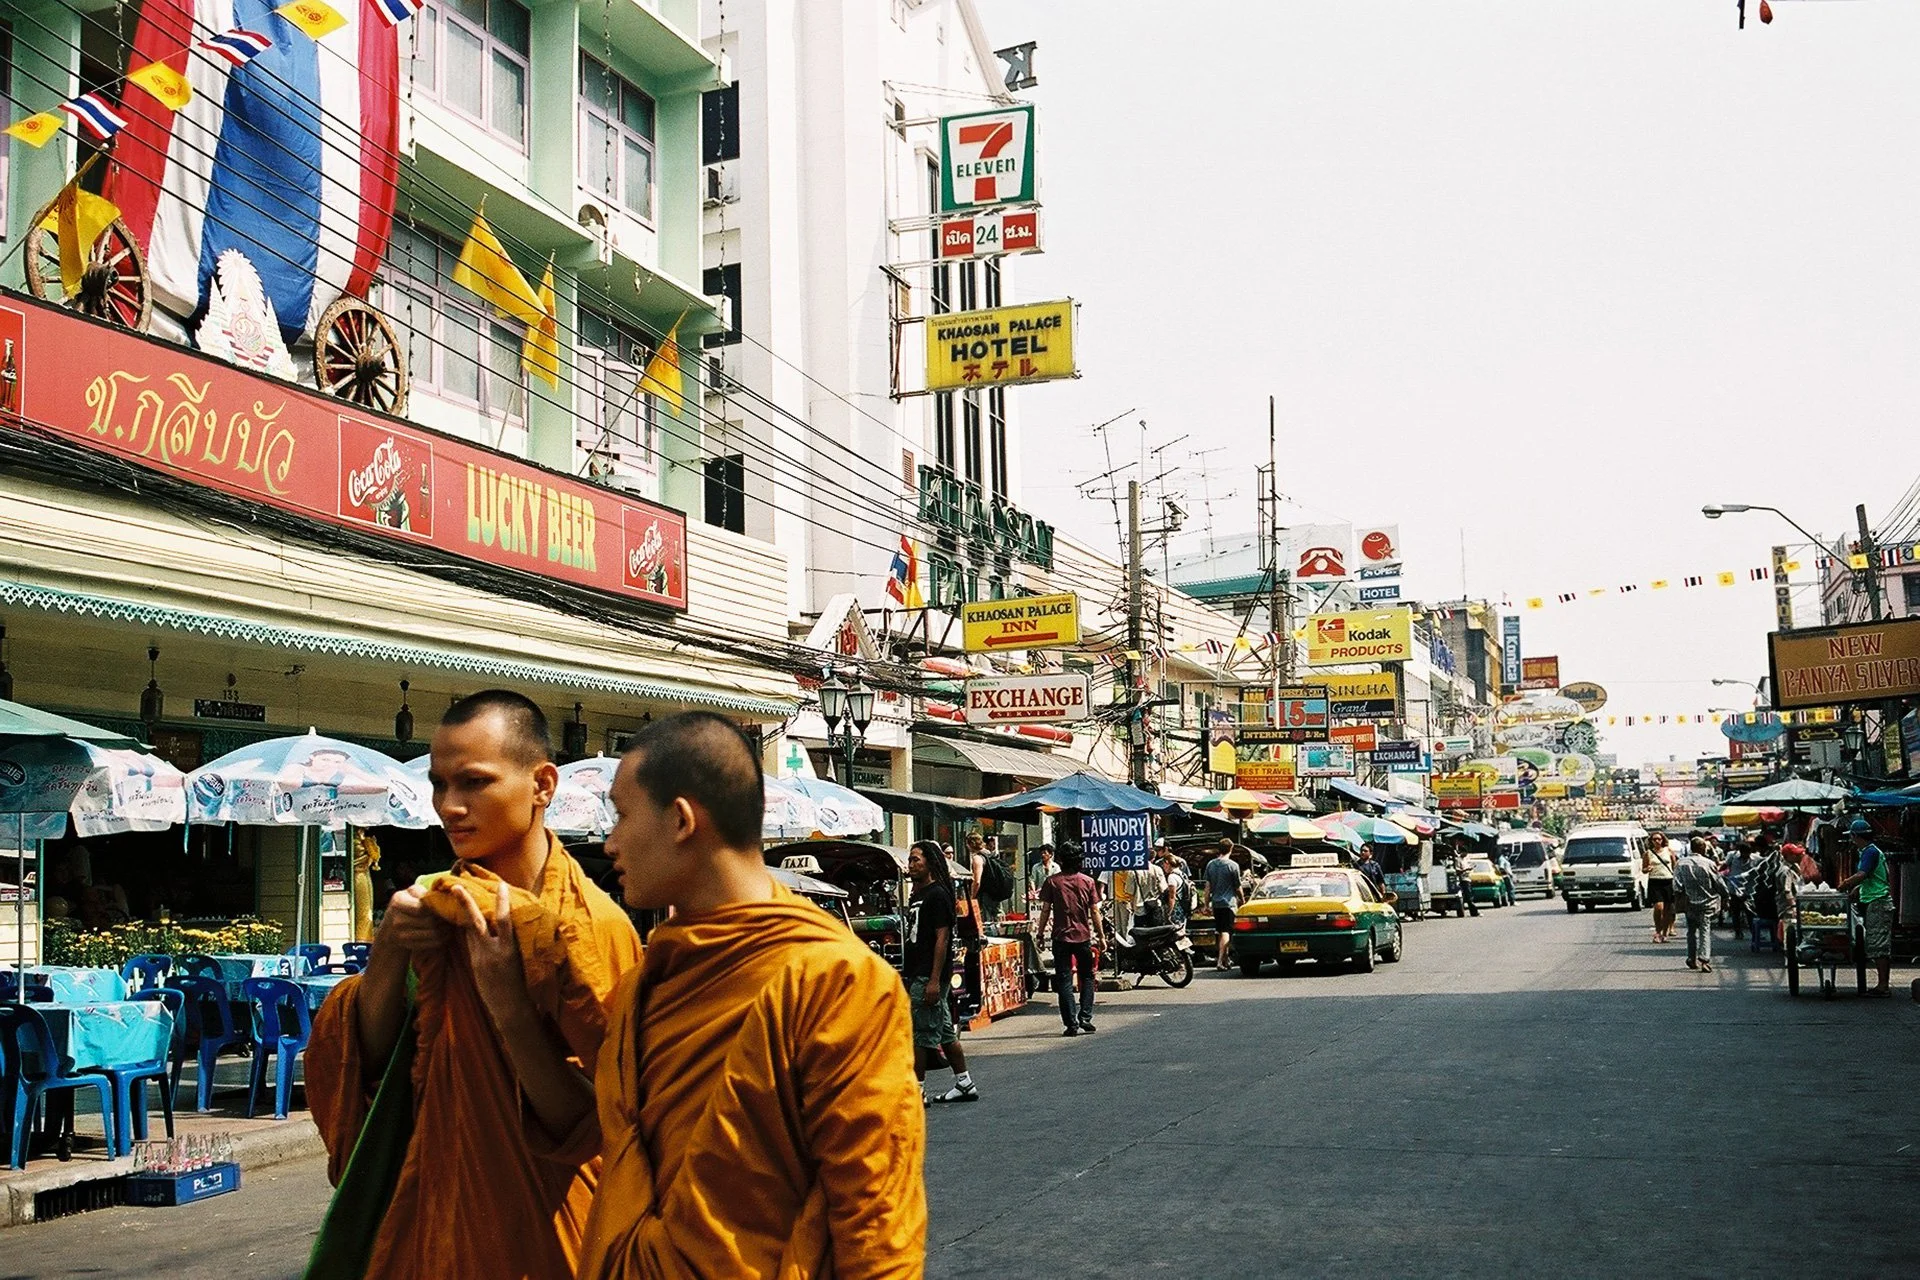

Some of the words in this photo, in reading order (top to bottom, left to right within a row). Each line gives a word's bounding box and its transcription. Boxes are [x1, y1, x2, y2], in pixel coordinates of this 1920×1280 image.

[945, 230, 971, 245] เปิด
[976, 224, 999, 245] 24
[938, 323, 1000, 341] KHAOSAN
[1009, 315, 1062, 333] PALACE
[951, 335, 1048, 362] HOTEL
[962, 358, 1038, 382] ホテル
[85, 370, 296, 495] ช.กลีบบัว
[467, 463, 542, 558] LUCKY
[547, 487, 596, 573] BEER
[1362, 588, 1398, 598] HOTEL
[967, 607, 1024, 624] KHAOSAN
[1028, 602, 1072, 618] PALACE
[1002, 619, 1038, 633] INN
[1349, 628, 1391, 641] Kodak
[1330, 643, 1403, 658] PRODUCTS
[1827, 633, 1883, 659] NEW
[1505, 635, 1519, 681] Konica
[1783, 665, 1851, 697] PANYA
[1856, 657, 1920, 690] SILVER
[223, 690, 239, 701] 133
[971, 687, 1083, 709] EXCHANGE
[1329, 684, 1390, 697] SINGHA
[1278, 701, 1306, 727] 15
[1332, 701, 1368, 713] Grand
[1243, 731, 1290, 739] INTERNET
[1330, 735, 1355, 744] ASSPORT
[1374, 751, 1416, 760] EXCHANGE
[853, 770, 885, 785] XCHANGE
[1081, 817, 1146, 838] LAUNDRY
[1082, 841, 1087, 853] 1
[1090, 841, 1107, 855] Kg
[1110, 839, 1130, 852] 30
[784, 857, 810, 869] TAXI
[1110, 855, 1130, 867] 20
